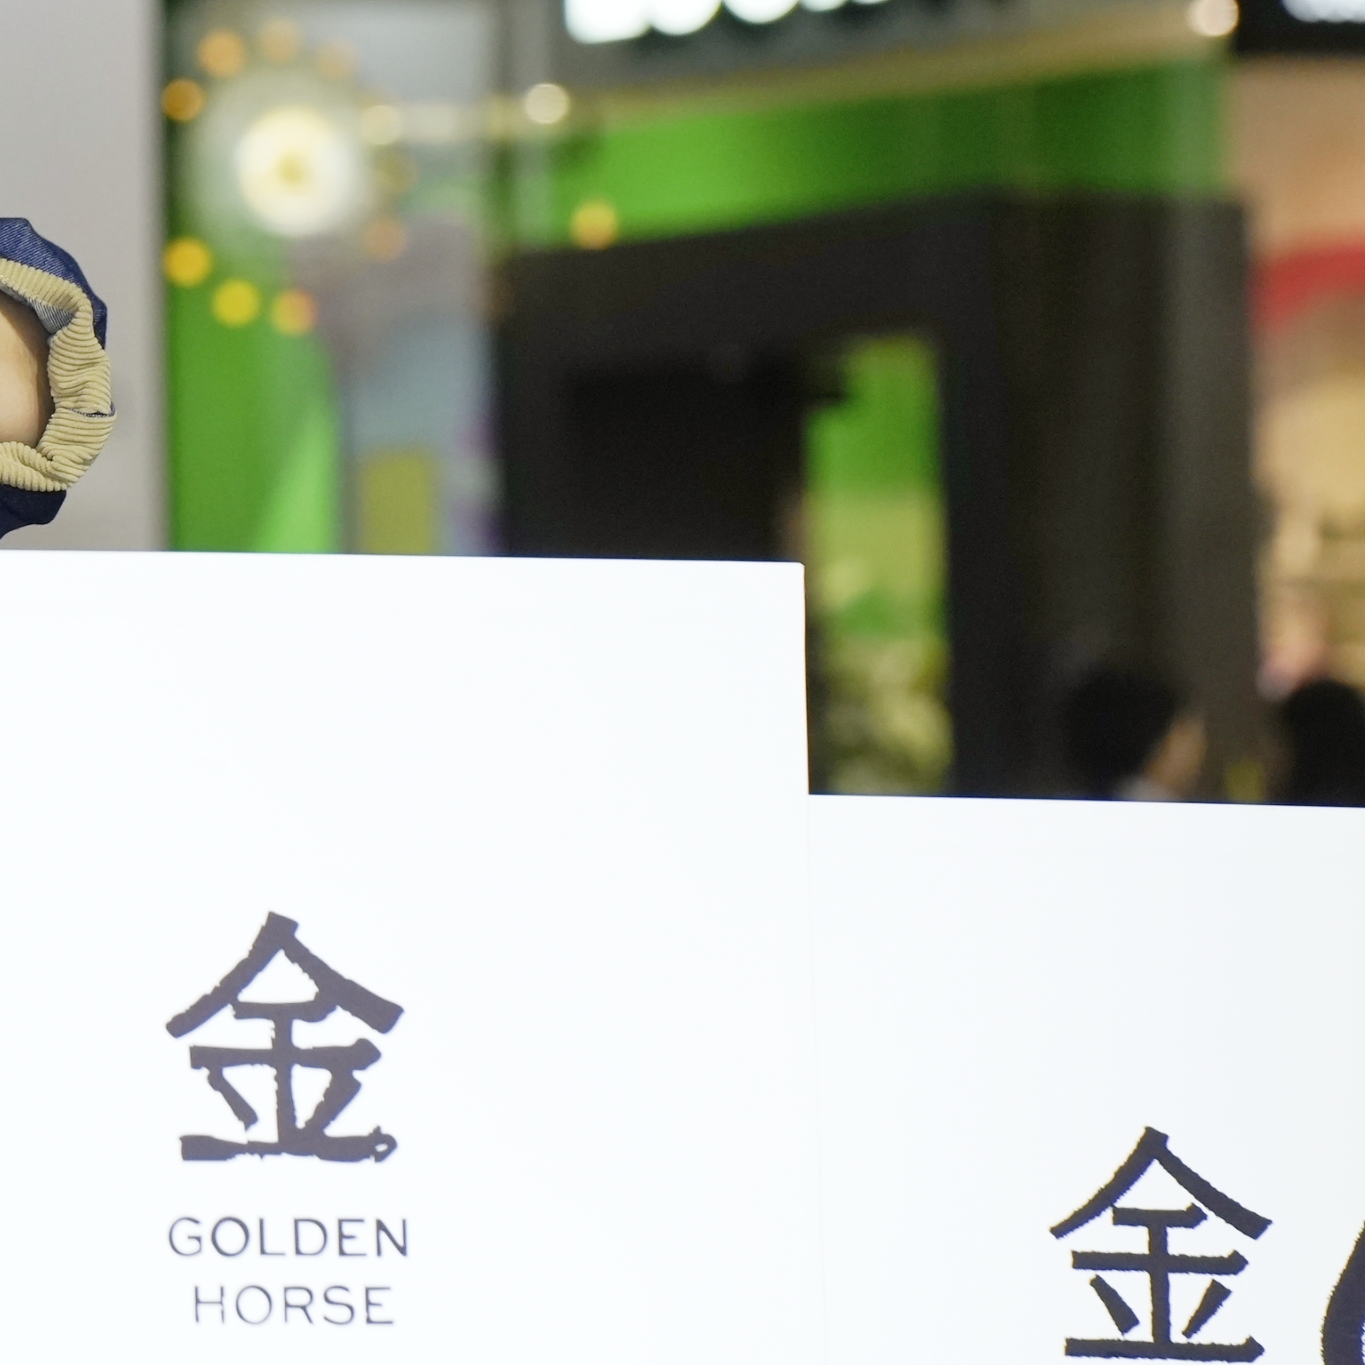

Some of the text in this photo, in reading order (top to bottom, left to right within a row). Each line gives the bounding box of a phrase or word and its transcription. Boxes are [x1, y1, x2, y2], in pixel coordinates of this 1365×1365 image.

[165, 910, 405, 1164] 金
[166, 1214, 410, 1260] GOLDEN
[192, 1283, 396, 1328] HORSE
[1048, 1125, 1274, 1365] 金
